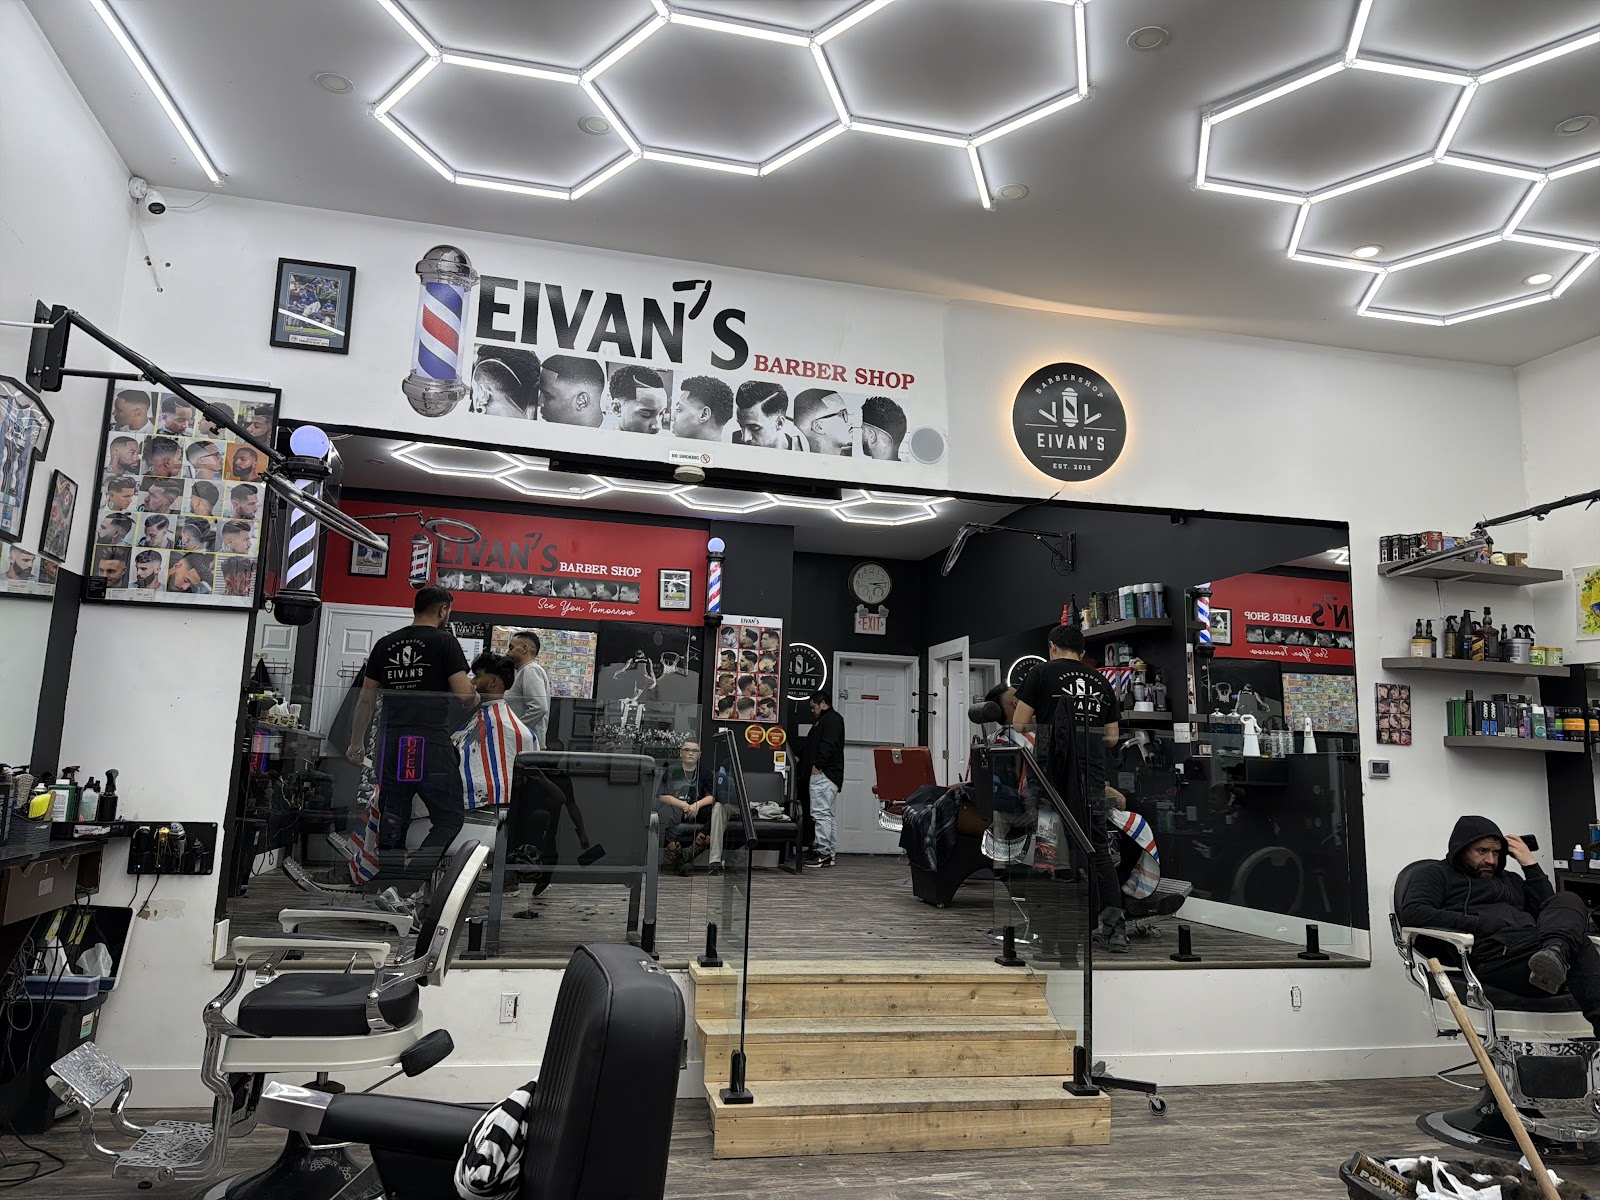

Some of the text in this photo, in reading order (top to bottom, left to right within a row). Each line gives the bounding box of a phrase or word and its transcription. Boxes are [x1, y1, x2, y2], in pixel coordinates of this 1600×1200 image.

[476, 275, 749, 370] EIVAN'S
[754, 354, 915, 390] BARBER SHOP
[1035, 374, 1104, 398] BARBERSHOP
[1037, 433, 1105, 451] EIVAN'S
[559, 562, 641, 577] BARBER SHOP
[538, 598, 636, 616] See You Tomorrow
[862, 616, 881, 631] EXIT
[387, 668, 423, 679] EIVAN'S
[790, 677, 816, 687] VAN'S
